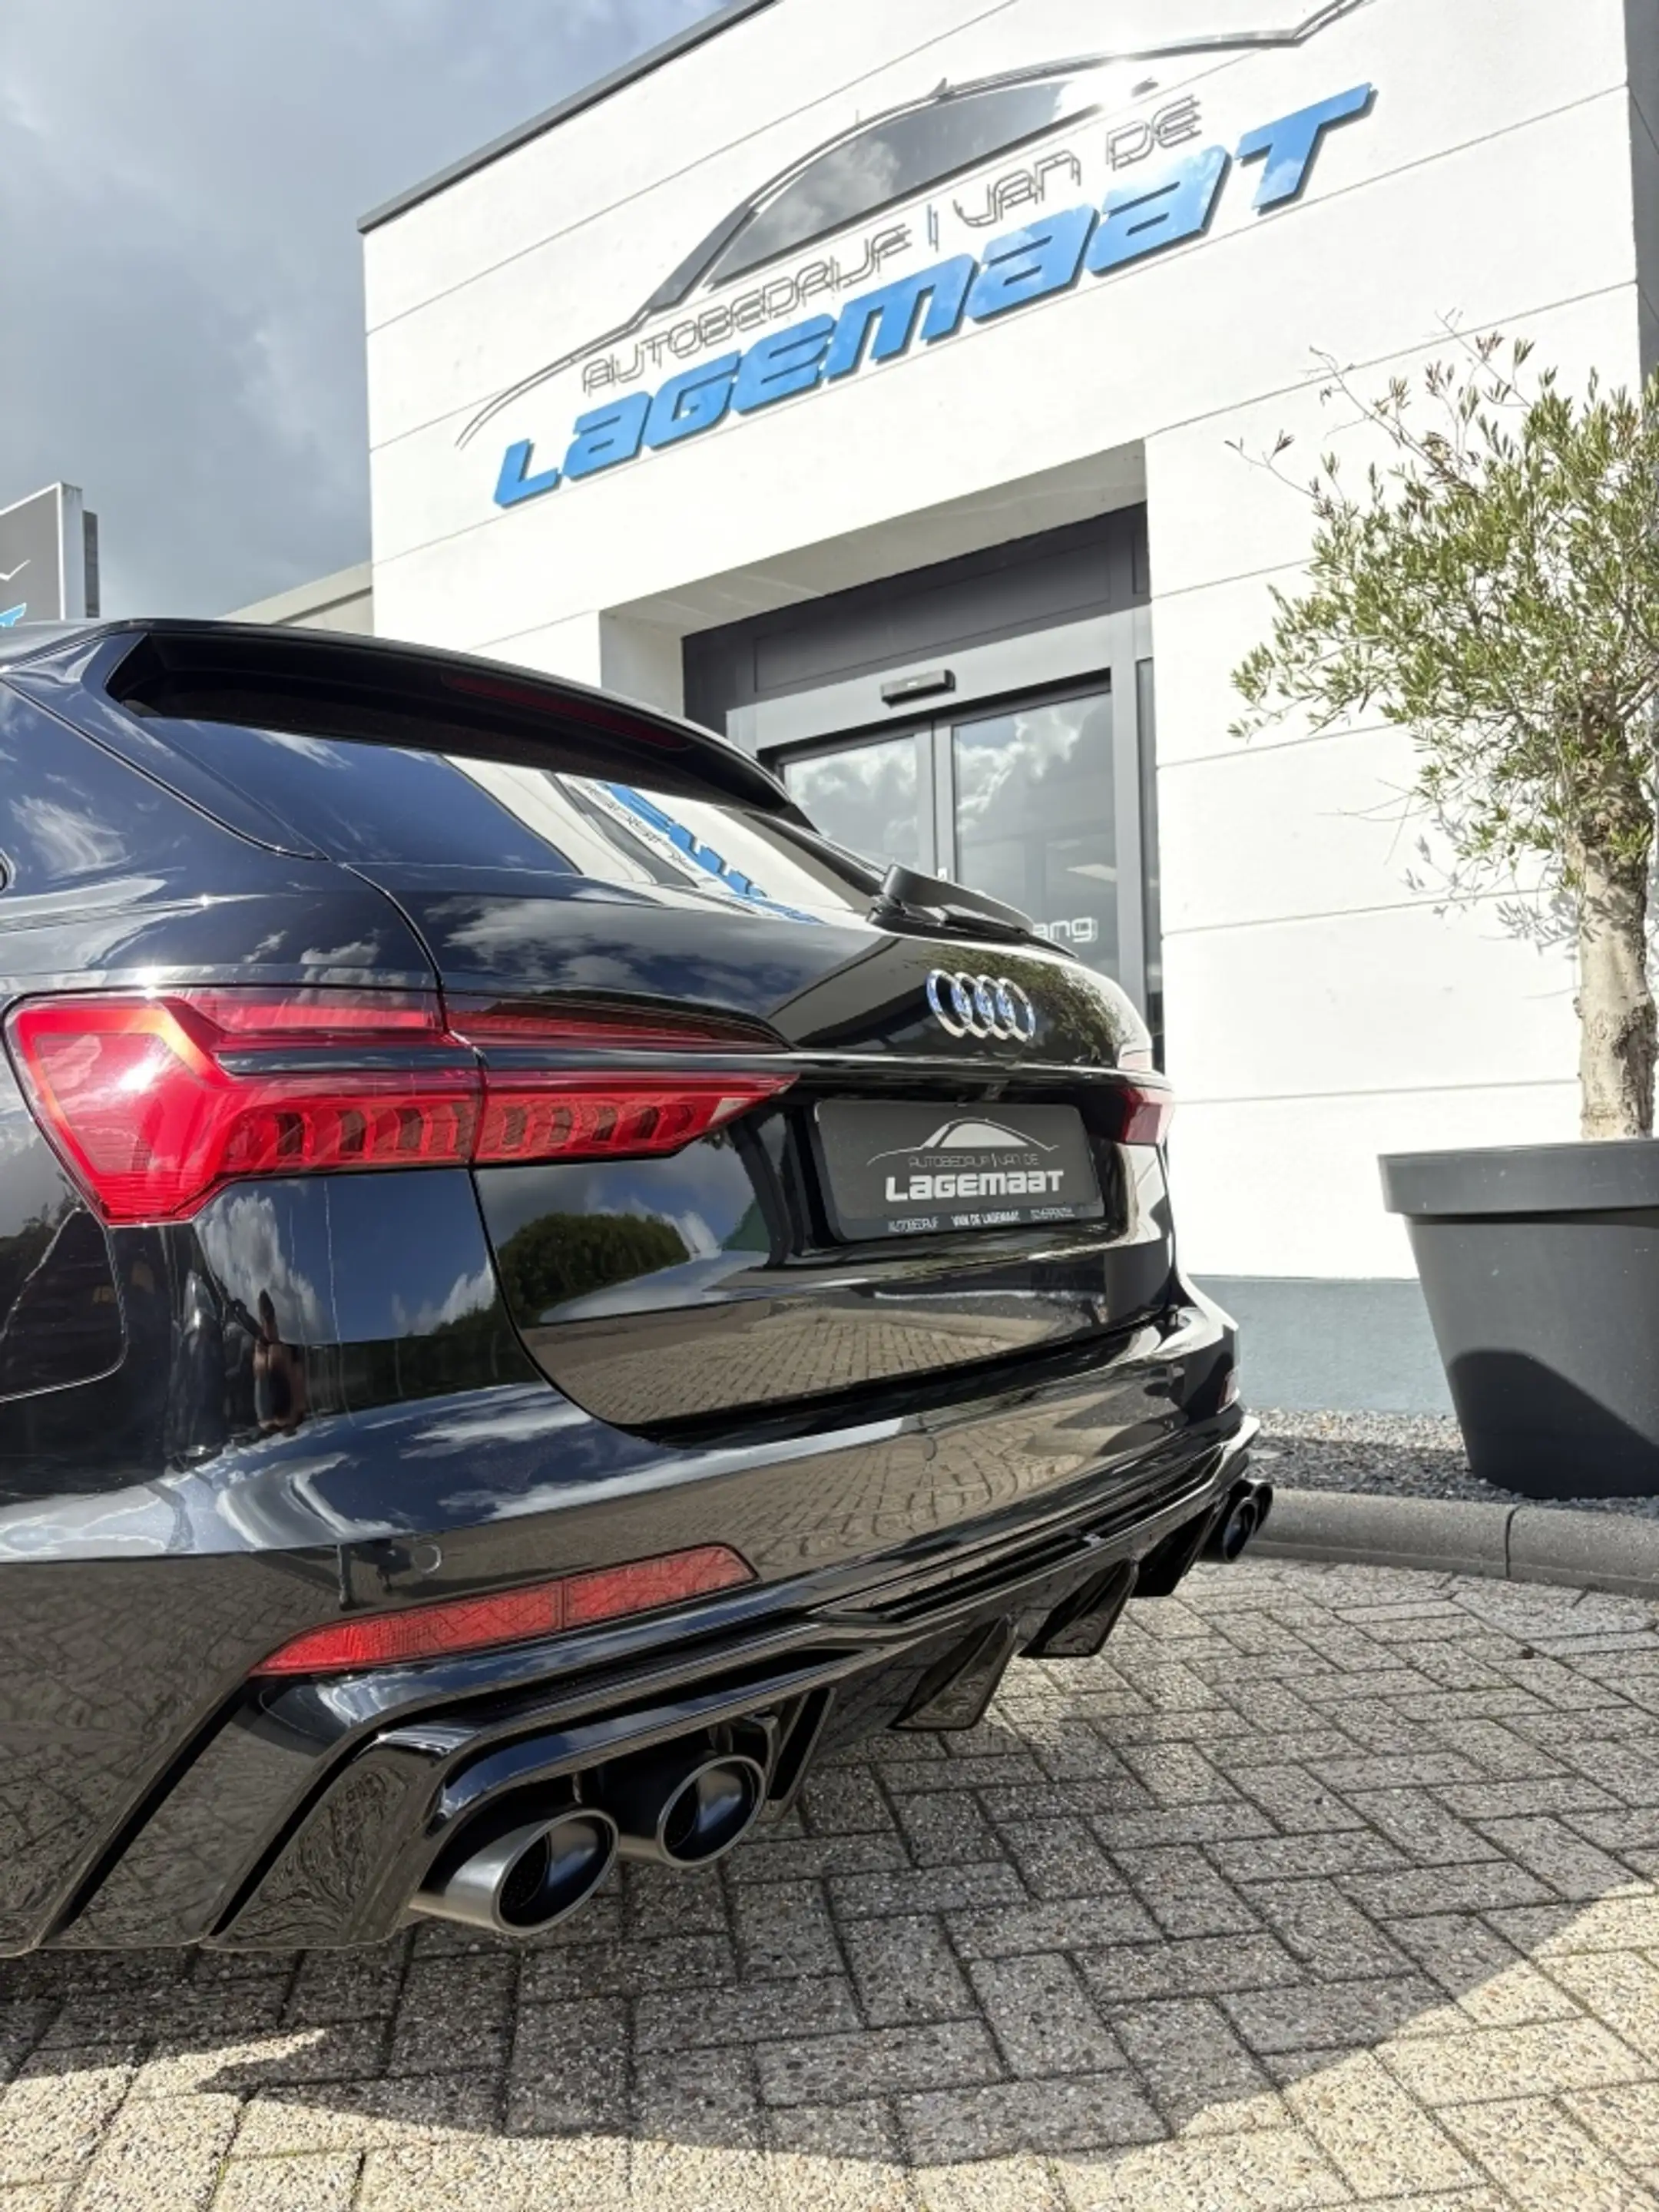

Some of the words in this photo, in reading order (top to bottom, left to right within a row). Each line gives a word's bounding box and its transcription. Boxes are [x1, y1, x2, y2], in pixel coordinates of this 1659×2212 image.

[581, 223, 912, 396] AUTOBEDRIJF
[952, 150, 1081, 228] VAN
[1106, 93, 1203, 171] DE
